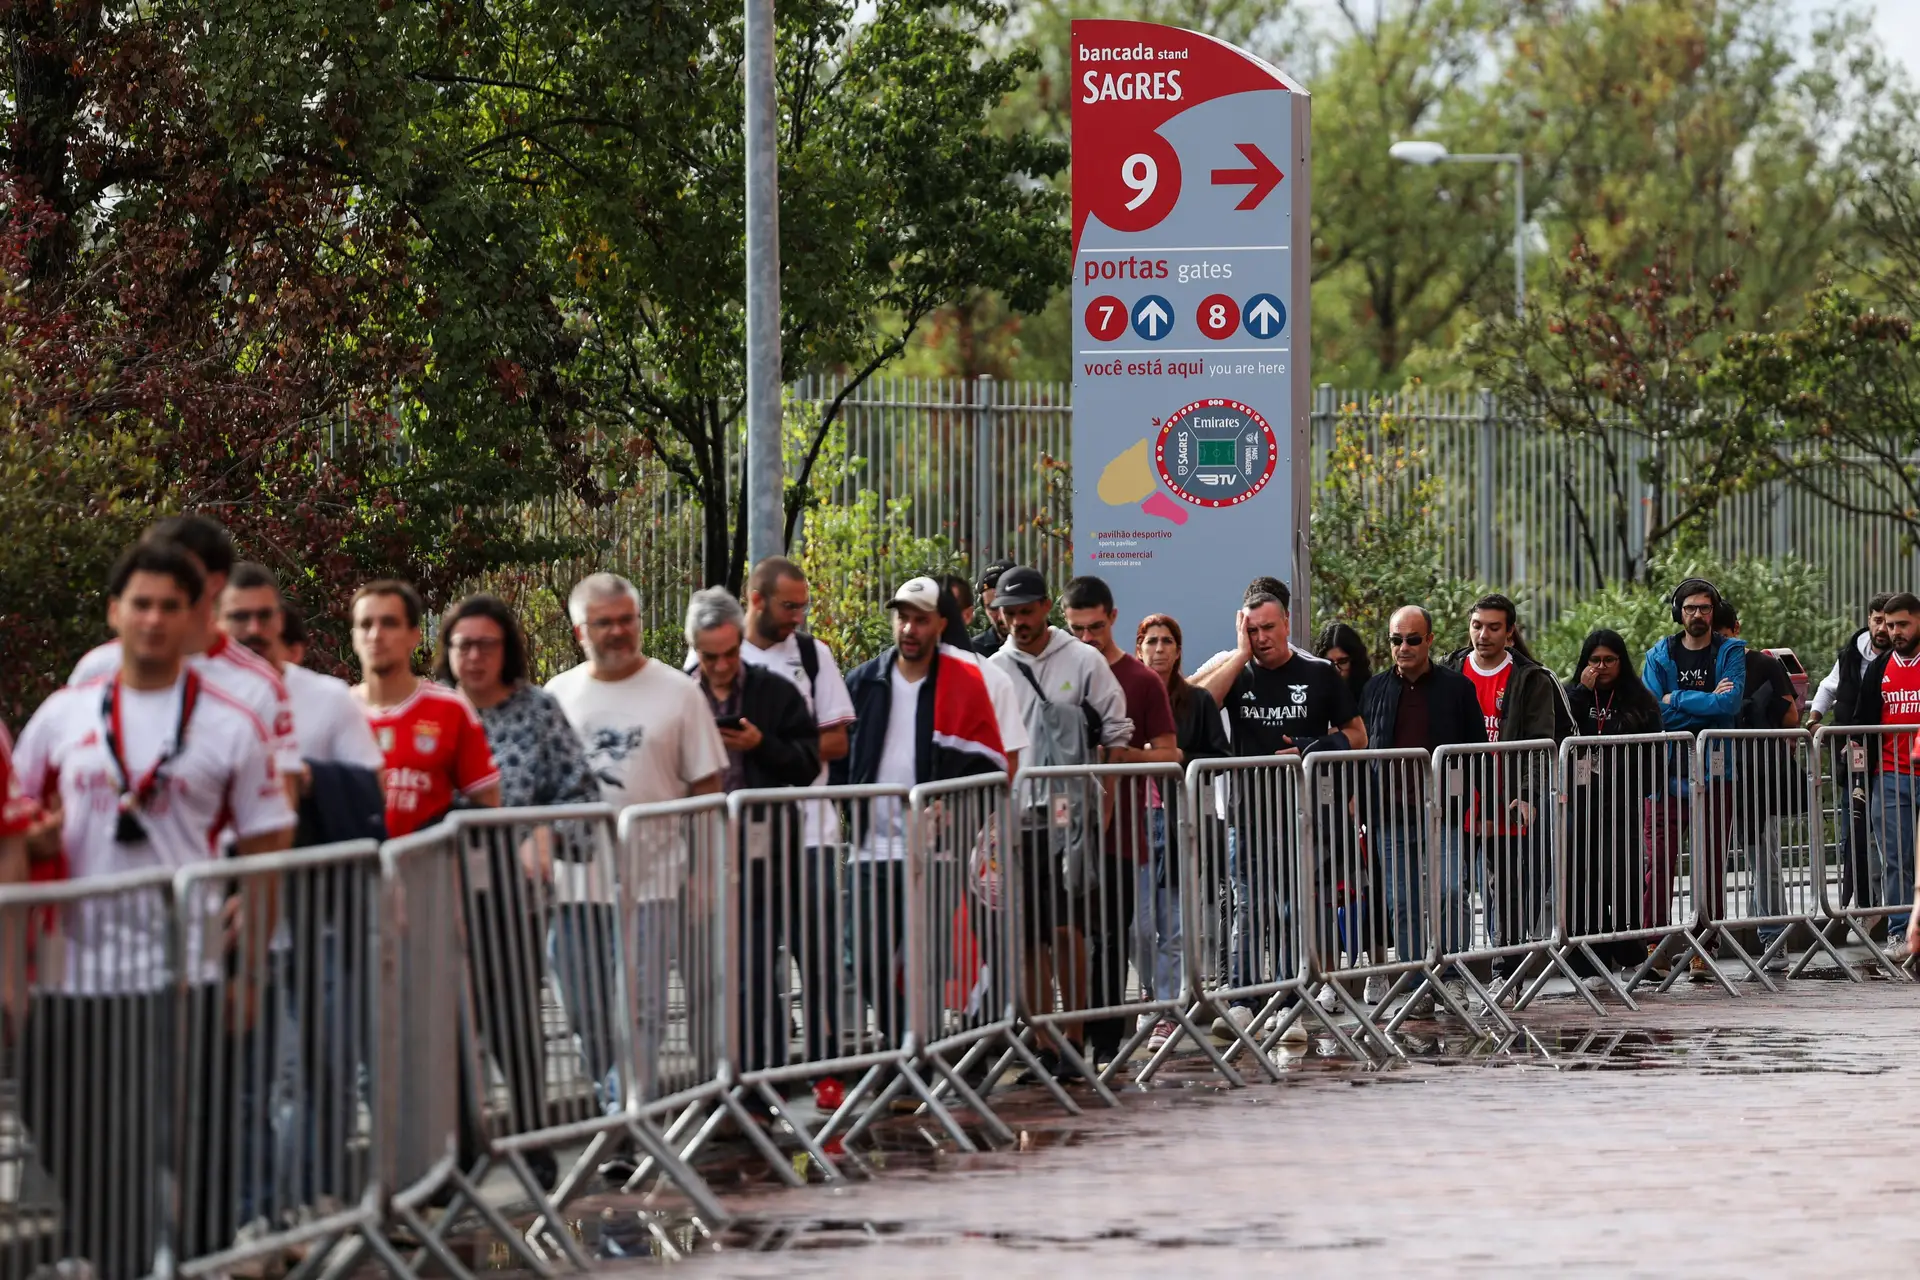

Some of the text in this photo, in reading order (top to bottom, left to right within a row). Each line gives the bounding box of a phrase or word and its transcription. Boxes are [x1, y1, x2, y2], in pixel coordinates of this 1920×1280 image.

[1079, 43, 1188, 61] bancada stand
[1082, 69, 1183, 104] SAGRES
[1121, 153, 1158, 211] 9
[1084, 256, 1233, 286] portas gates
[1098, 304, 1227, 331] 7 8
[1084, 358, 1285, 378] você está aqui you are here
[1193, 416, 1240, 428] Emirates
[1178, 431, 1188, 465] SAGRES
[1098, 530, 1172, 540] pavilhão desportivo
[1098, 540, 1116, 548] sports
[1098, 550, 1153, 559] área comercial
[1098, 559, 1128, 567] commercial
[1240, 705, 1308, 719] BALMAIN
[1900, 702, 1920, 713] BETT
